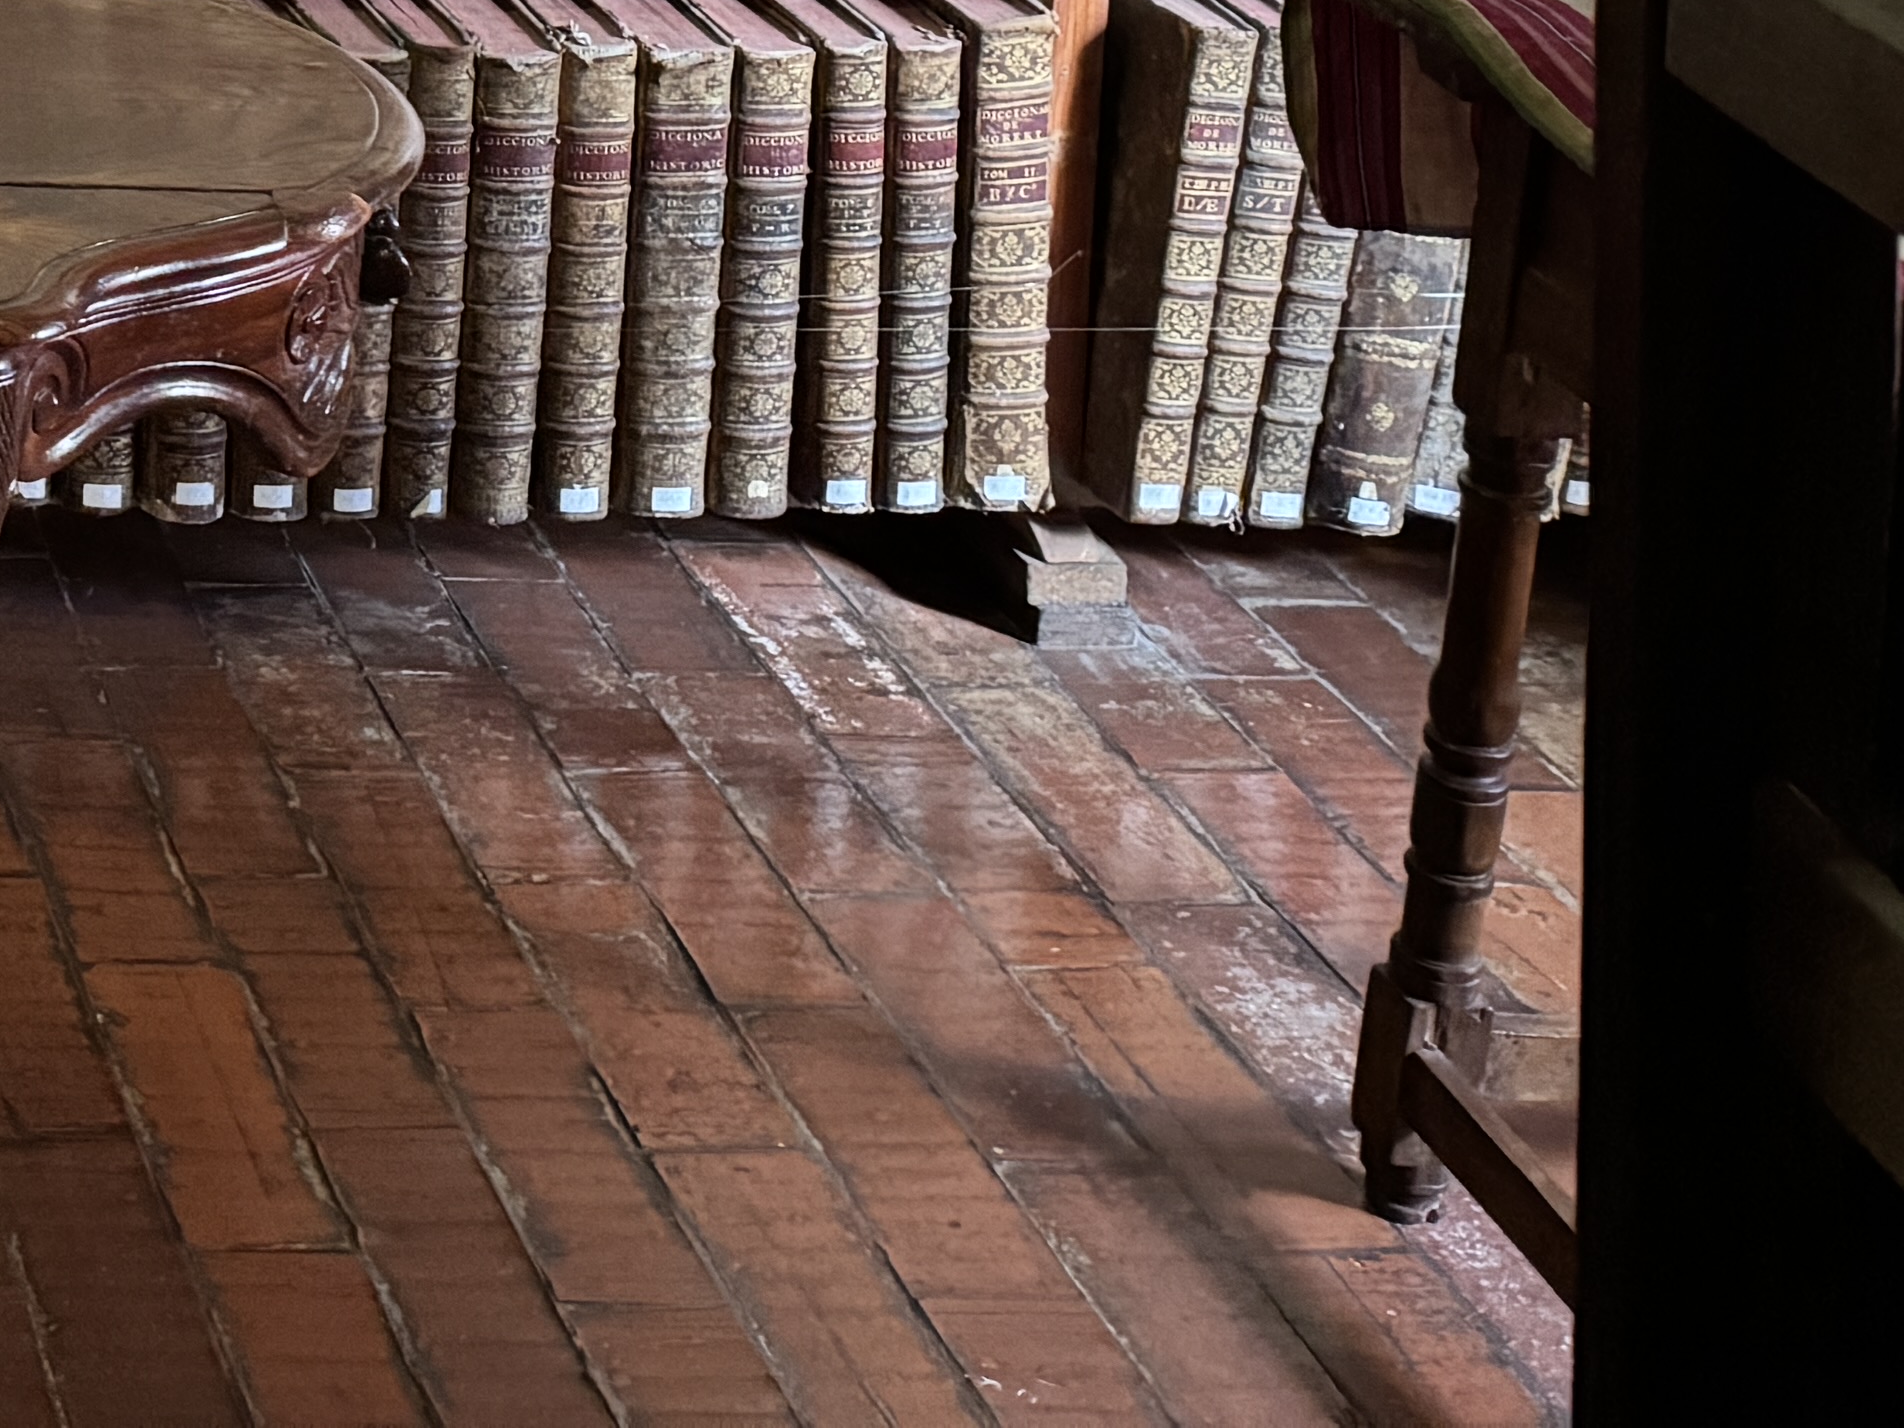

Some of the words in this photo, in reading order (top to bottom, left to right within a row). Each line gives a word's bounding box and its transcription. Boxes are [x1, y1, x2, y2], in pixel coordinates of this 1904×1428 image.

[1003, 120, 1020, 131] DE
[1202, 128, 1221, 138] DE
[1268, 128, 1286, 138] DE
